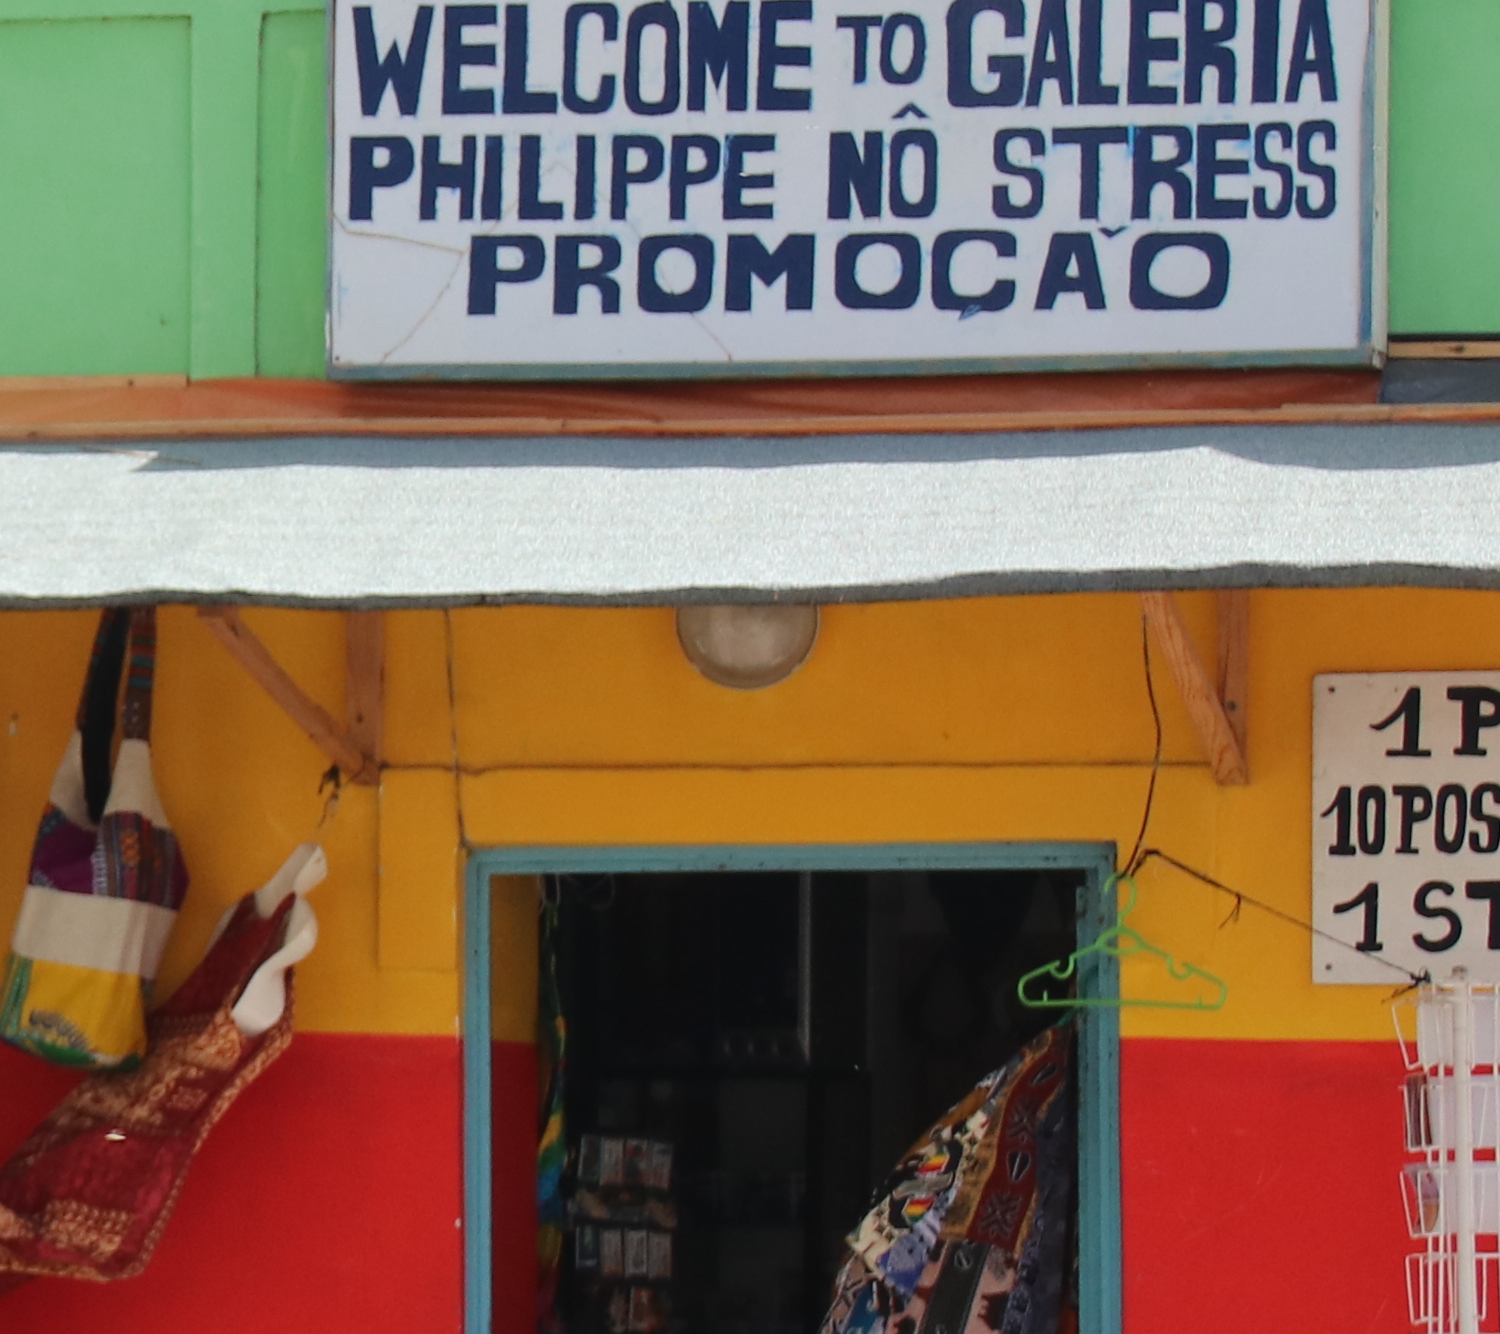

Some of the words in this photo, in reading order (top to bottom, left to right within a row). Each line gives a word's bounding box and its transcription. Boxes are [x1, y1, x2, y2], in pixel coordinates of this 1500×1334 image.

[836, 12, 926, 85] TO
[348, 131, 775, 222] PHILIPPE
[828, 103, 938, 221] NÔ
[992, 119, 1338, 220] STRESS
[467, 225, 1231, 320] PROMOÇÃO
[1370, 687, 1431, 757] 1
[1321, 784, 1385, 855] 10
[1333, 882, 1383, 952] 1
